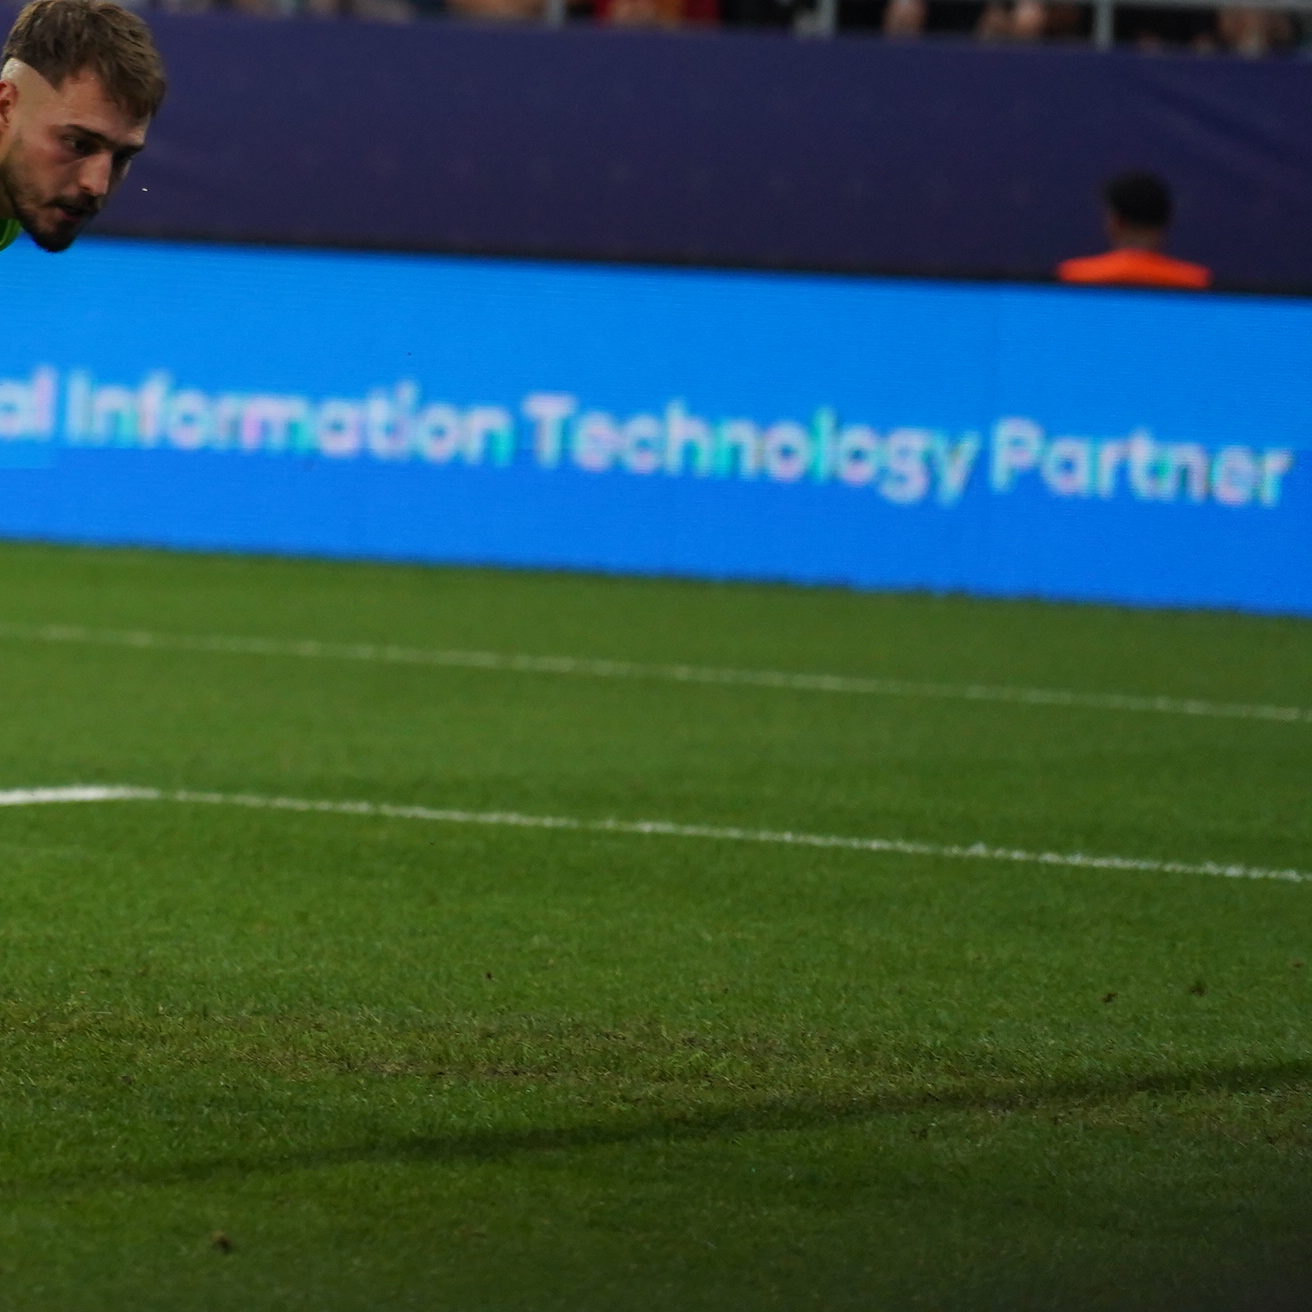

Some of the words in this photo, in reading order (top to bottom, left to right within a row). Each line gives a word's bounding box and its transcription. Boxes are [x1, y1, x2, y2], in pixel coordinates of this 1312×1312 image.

[67, 368, 514, 466] Information
[525, 392, 980, 506] Technology
[991, 416, 1293, 508] Partner
